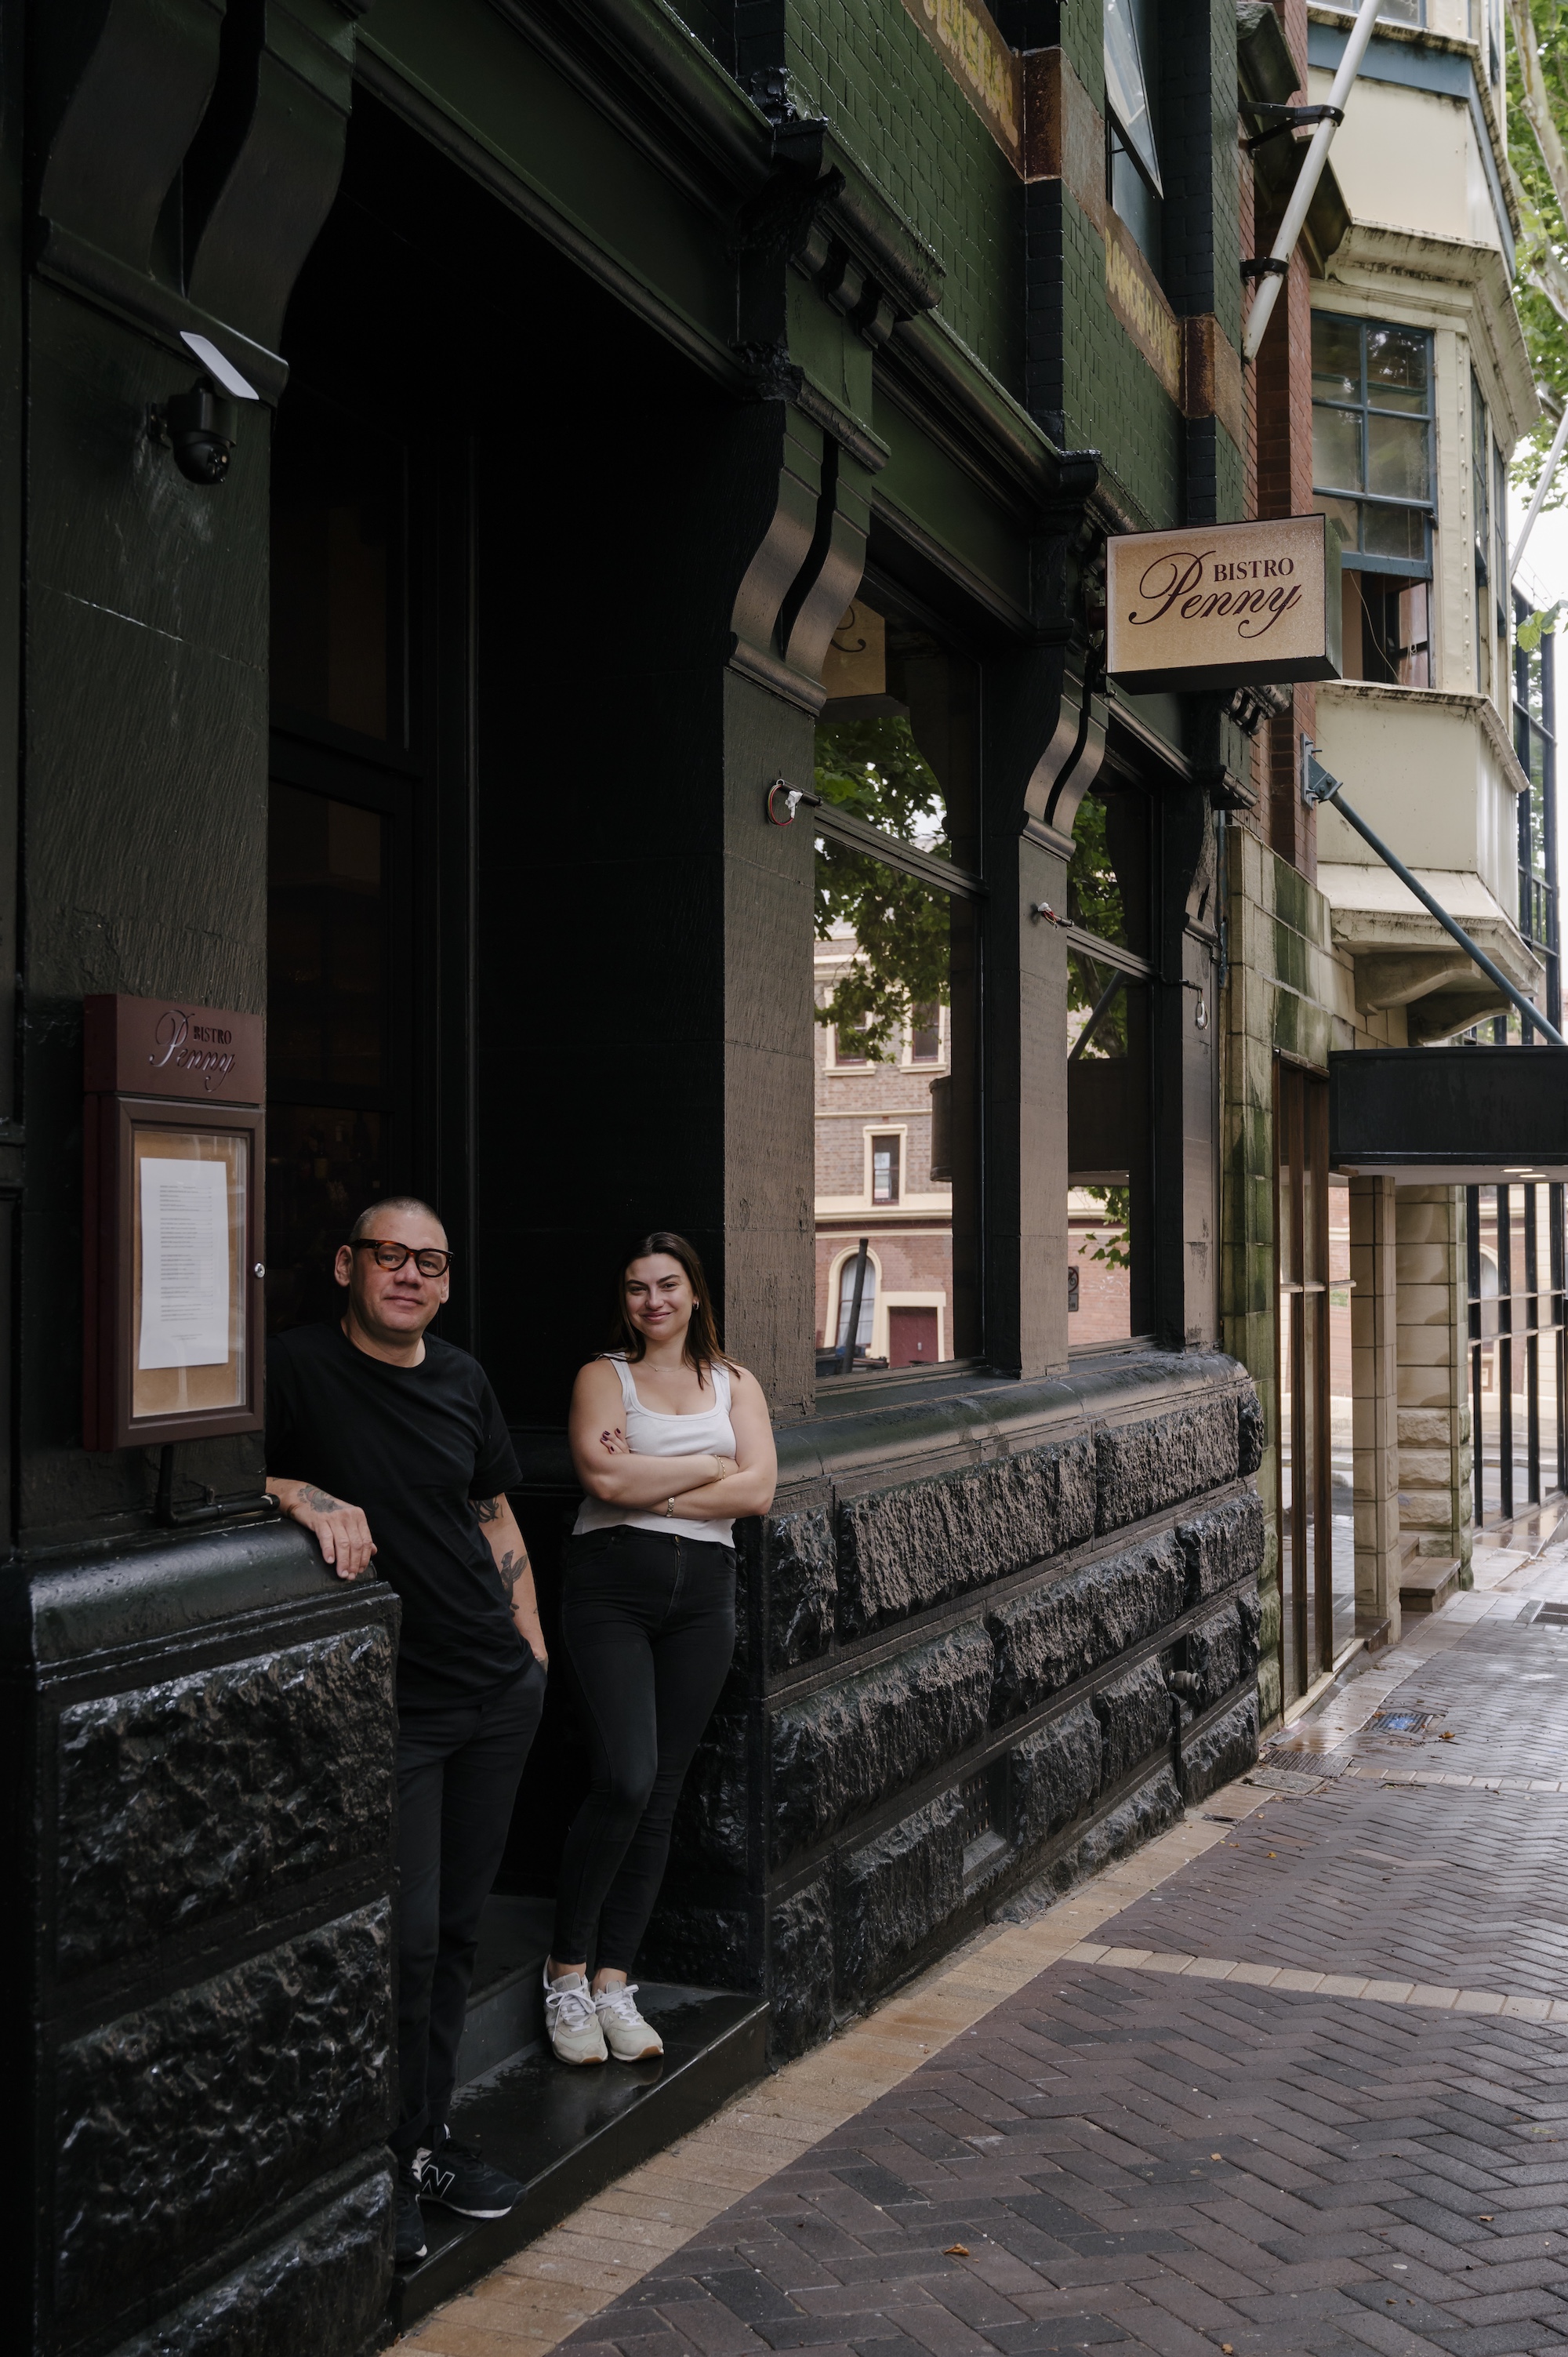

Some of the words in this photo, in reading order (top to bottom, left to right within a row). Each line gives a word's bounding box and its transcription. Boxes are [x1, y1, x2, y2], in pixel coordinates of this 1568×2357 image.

[1129, 550, 1302, 638] Penny
[1214, 557, 1294, 582] BISTRO
[149, 1009, 236, 1092] Penny
[193, 1026, 232, 1045] BISTRO
